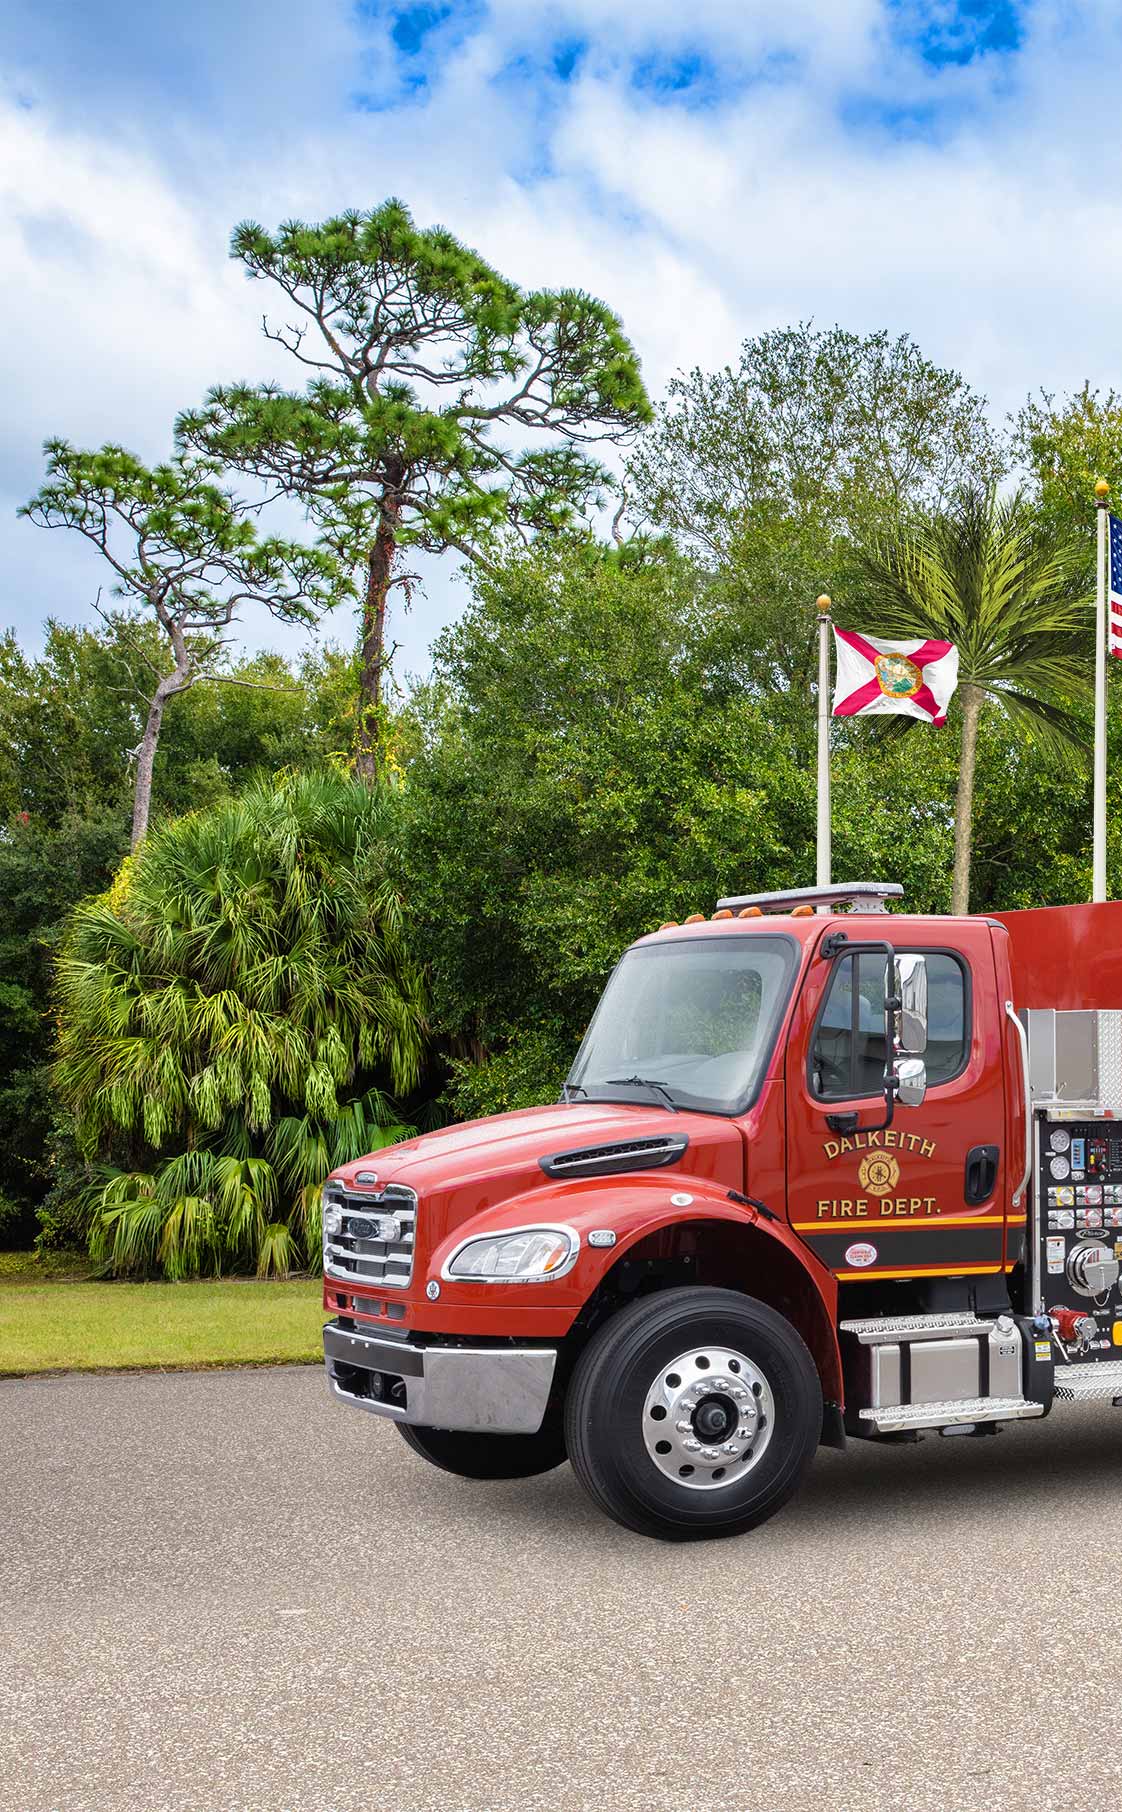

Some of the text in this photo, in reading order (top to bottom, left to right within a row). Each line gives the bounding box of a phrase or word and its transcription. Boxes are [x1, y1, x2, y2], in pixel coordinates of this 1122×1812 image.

[822, 1130, 937, 1160] DALKEITH
[816, 1198, 941, 1218] FIRE DEPT.
